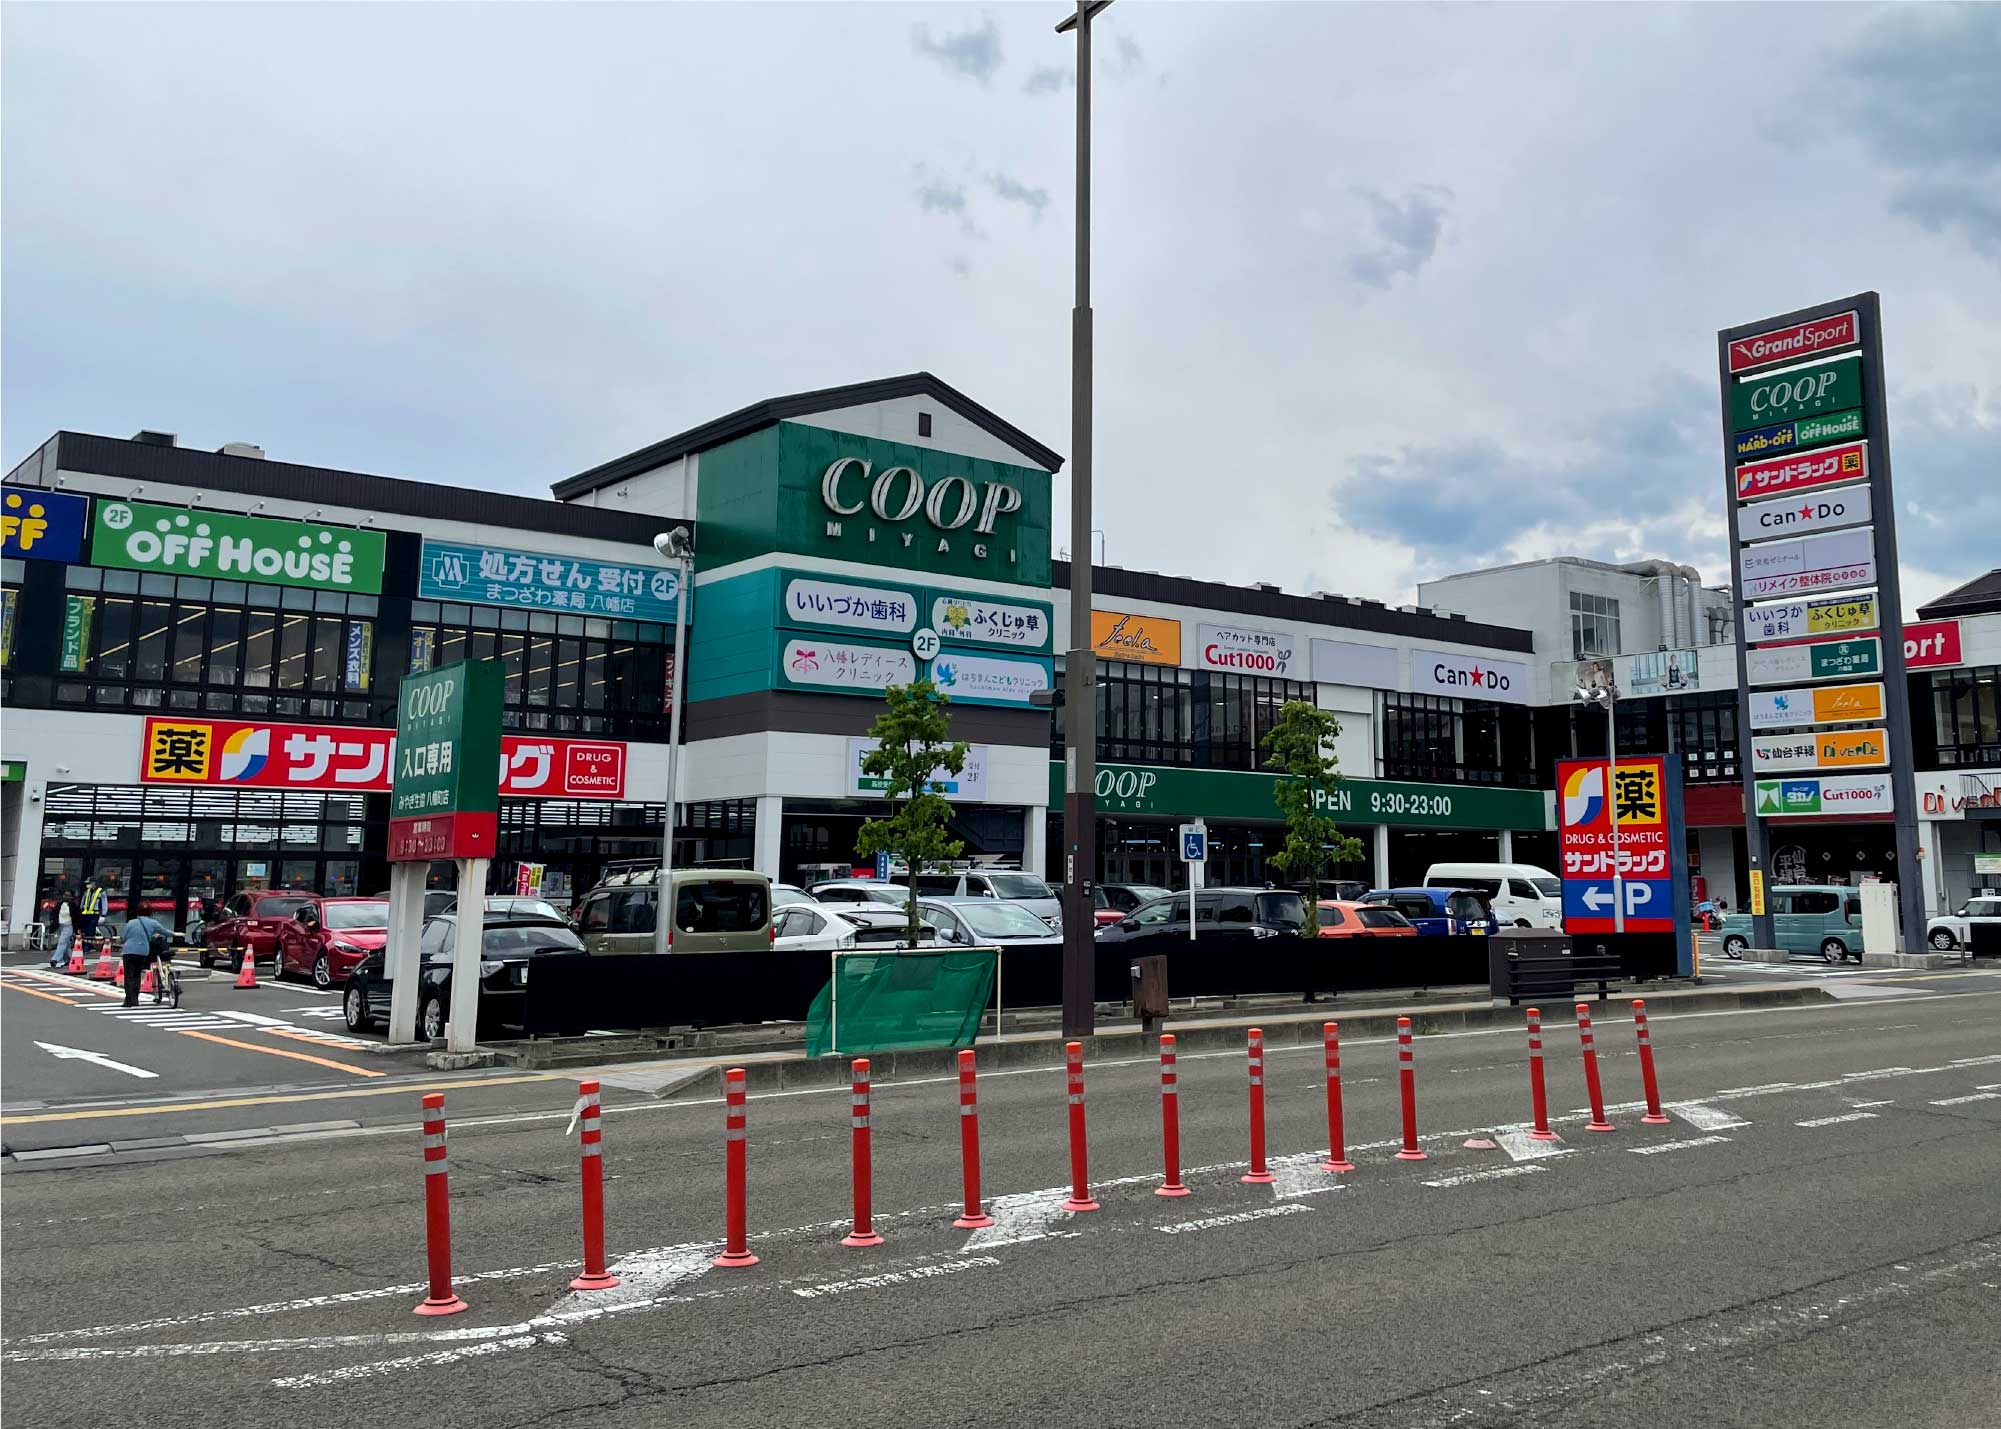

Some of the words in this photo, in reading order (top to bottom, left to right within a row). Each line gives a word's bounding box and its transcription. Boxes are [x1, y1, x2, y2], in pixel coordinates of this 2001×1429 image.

[1750, 372, 1837, 412] COOP
[1752, 397, 1836, 420] MIYAGI
[1755, 456, 1839, 487] サンドラッグ
[821, 457, 1022, 534] COOP
[108, 510, 129, 525] 2F
[1760, 512, 1796, 528] Can
[1818, 503, 1845, 519] Do
[1, 514, 48, 550] FF
[826, 521, 1017, 562] MIYAGI
[126, 530, 213, 567] OFF
[218, 536, 354, 584] HOUSE
[478, 550, 592, 590] 処方せん
[597, 567, 645, 595] 受付
[1759, 572, 1833, 593] リメイク整体院
[654, 576, 676, 595] 2F
[485, 583, 586, 610] まつざわ薬局
[590, 594, 635, 613] 八幡店
[796, 592, 907, 623] いいづか歯科
[974, 608, 1040, 631] ふくじゅ草
[1749, 606, 1803, 623] いいづか
[1812, 602, 1871, 621] ふくじゅ草
[988, 627, 1026, 640] クリニック
[1763, 620, 1790, 636] 歯科
[1824, 618, 1860, 630] クリニック
[917, 636, 937, 652] 2F
[1216, 631, 1276, 647] ヘアカット専門店
[1904, 633, 1945, 659] ort
[824, 649, 908, 669] 八幡レディース
[1205, 644, 1275, 671] Cut1000
[836, 667, 895, 683] クリニック
[1434, 664, 1468, 686] Can
[1486, 670, 1510, 691] Do
[408, 679, 454, 720] COOP
[153, 728, 206, 774] 薬
[402, 740, 453, 778] 入口専用
[576, 752, 612, 763] DRUG
[1772, 745, 1815, 759] 仙台平禄
[569, 774, 616, 786] COSMETIC
[590, 765, 598, 774] &
[1095, 769, 1156, 797] OOP
[1615, 770, 1656, 819] 薬
[1823, 788, 1872, 801] Cut1000
[1105, 800, 1153, 808] YAGI
[1371, 792, 1450, 816] 9:30-23:00
[1565, 833, 1594, 844] DRUG
[1598, 833, 1605, 843] &
[1608, 832, 1663, 844] COSMETIC
[1565, 850, 1666, 873] サンドラッグ
[1626, 882, 1652, 915] P
